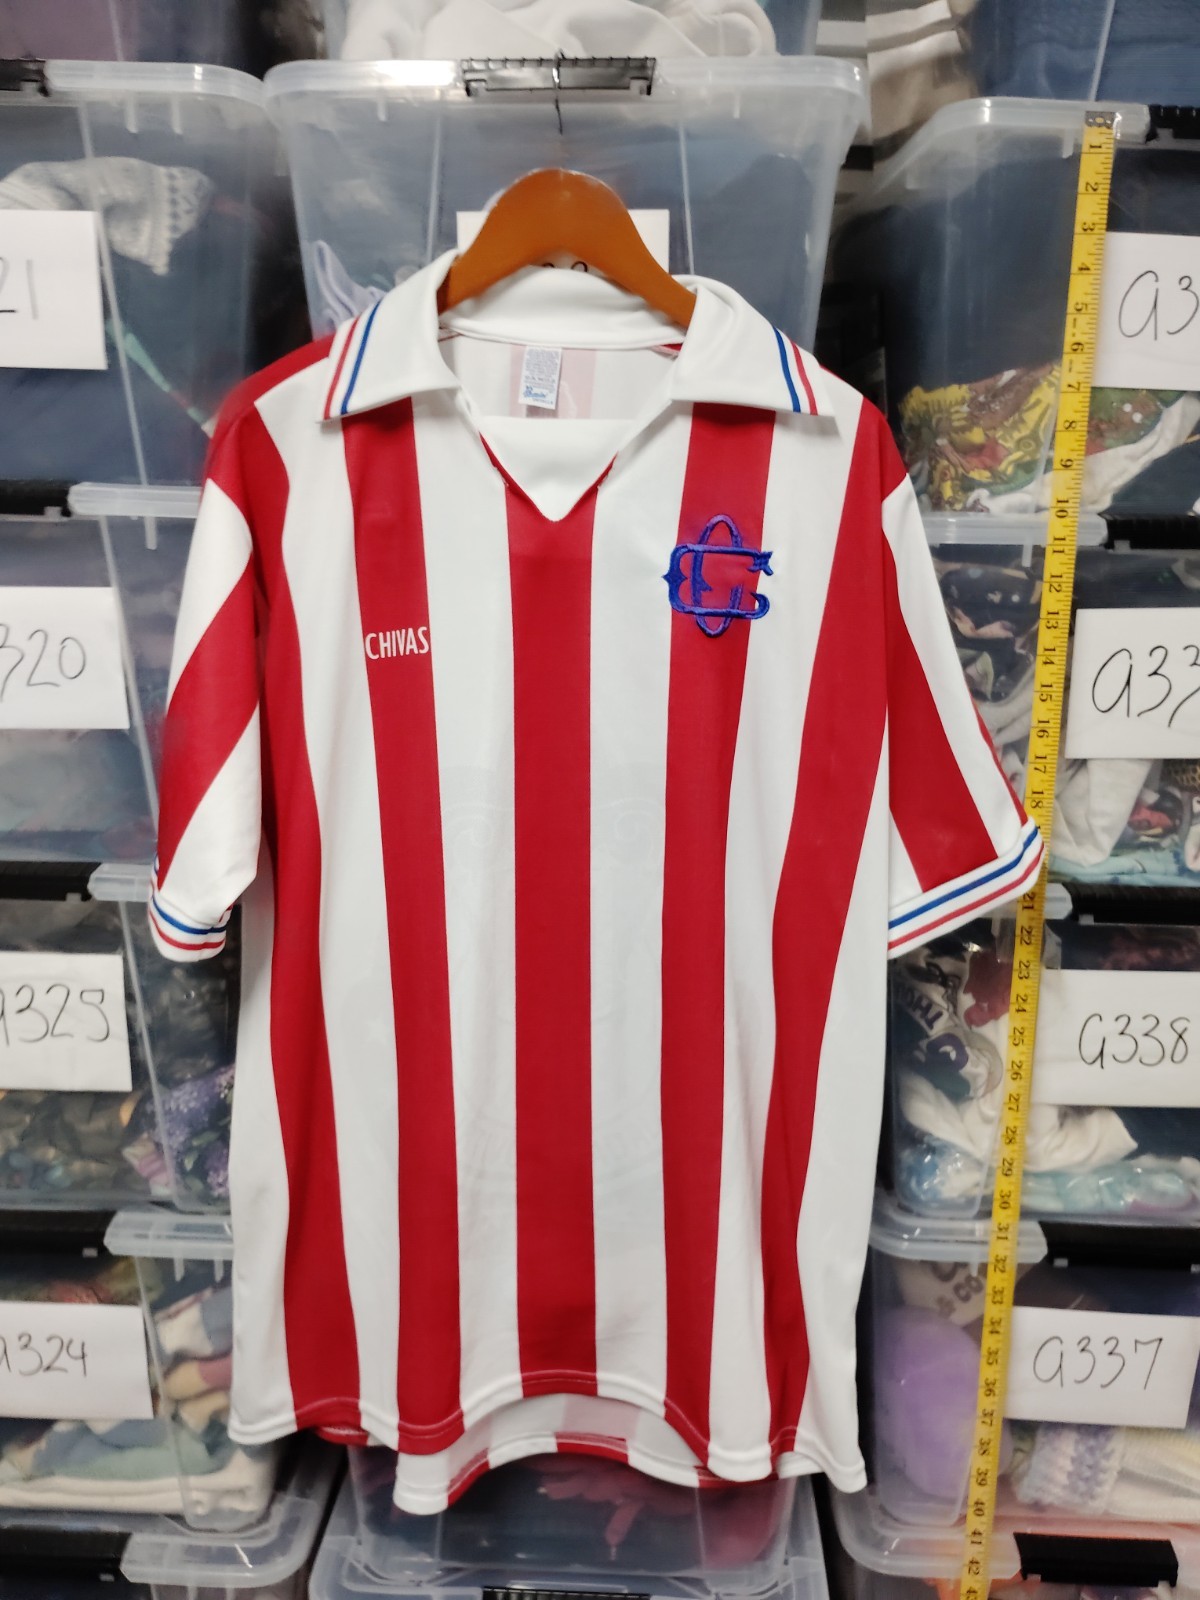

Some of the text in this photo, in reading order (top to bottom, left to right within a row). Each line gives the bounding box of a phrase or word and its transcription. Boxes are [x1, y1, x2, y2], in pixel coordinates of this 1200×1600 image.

[1085, 182, 1099, 192] 2
[1081, 222, 1096, 232] 3
[1077, 262, 1091, 272] 4
[1074, 302, 1088, 312] 5
[1071, 342, 1085, 352] 6
[1067, 381, 1081, 392] 7
[1063, 420, 1078, 430] 8
[1060, 458, 1074, 469] 9
[1055, 498, 1069, 518] 10
[1052, 536, 1067, 554] 11
[1049, 573, 1063, 593] 12
[1045, 610, 1060, 630] 13
[364, 626, 430, 660] CHIVAS
[1042, 646, 1056, 666] 14
[1038, 683, 1053, 702] 15
[1036, 719, 1050, 739] 16
[1033, 754, 1048, 774] 17
[1030, 789, 1045, 809] 18
[1020, 925, 1033, 946] 22
[1017, 960, 1031, 980] 23
[1015, 993, 1029, 1014] 24
[1012, 1026, 1026, 1047] 25
[1010, 1060, 1024, 1081] 26
[1007, 1093, 1020, 1113] 27
[1004, 1125, 1018, 1146] 28
[1001, 1157, 1015, 1177] 29
[998, 1190, 1012, 1210] 30
[996, 1222, 1010, 1241] 31
[993, 1254, 1007, 1274] 32
[991, 1285, 1005, 1305] 33
[988, 1316, 1002, 1335] 34
[986, 1346, 1000, 1366] 35
[984, 1377, 997, 1397] 36
[981, 1408, 994, 1427] 37
[978, 1437, 991, 1456] 38
[975, 1467, 989, 1487] 39
[973, 1498, 986, 1517] 40
[970, 1528, 983, 1545] 41
[967, 1557, 981, 1576] 42
